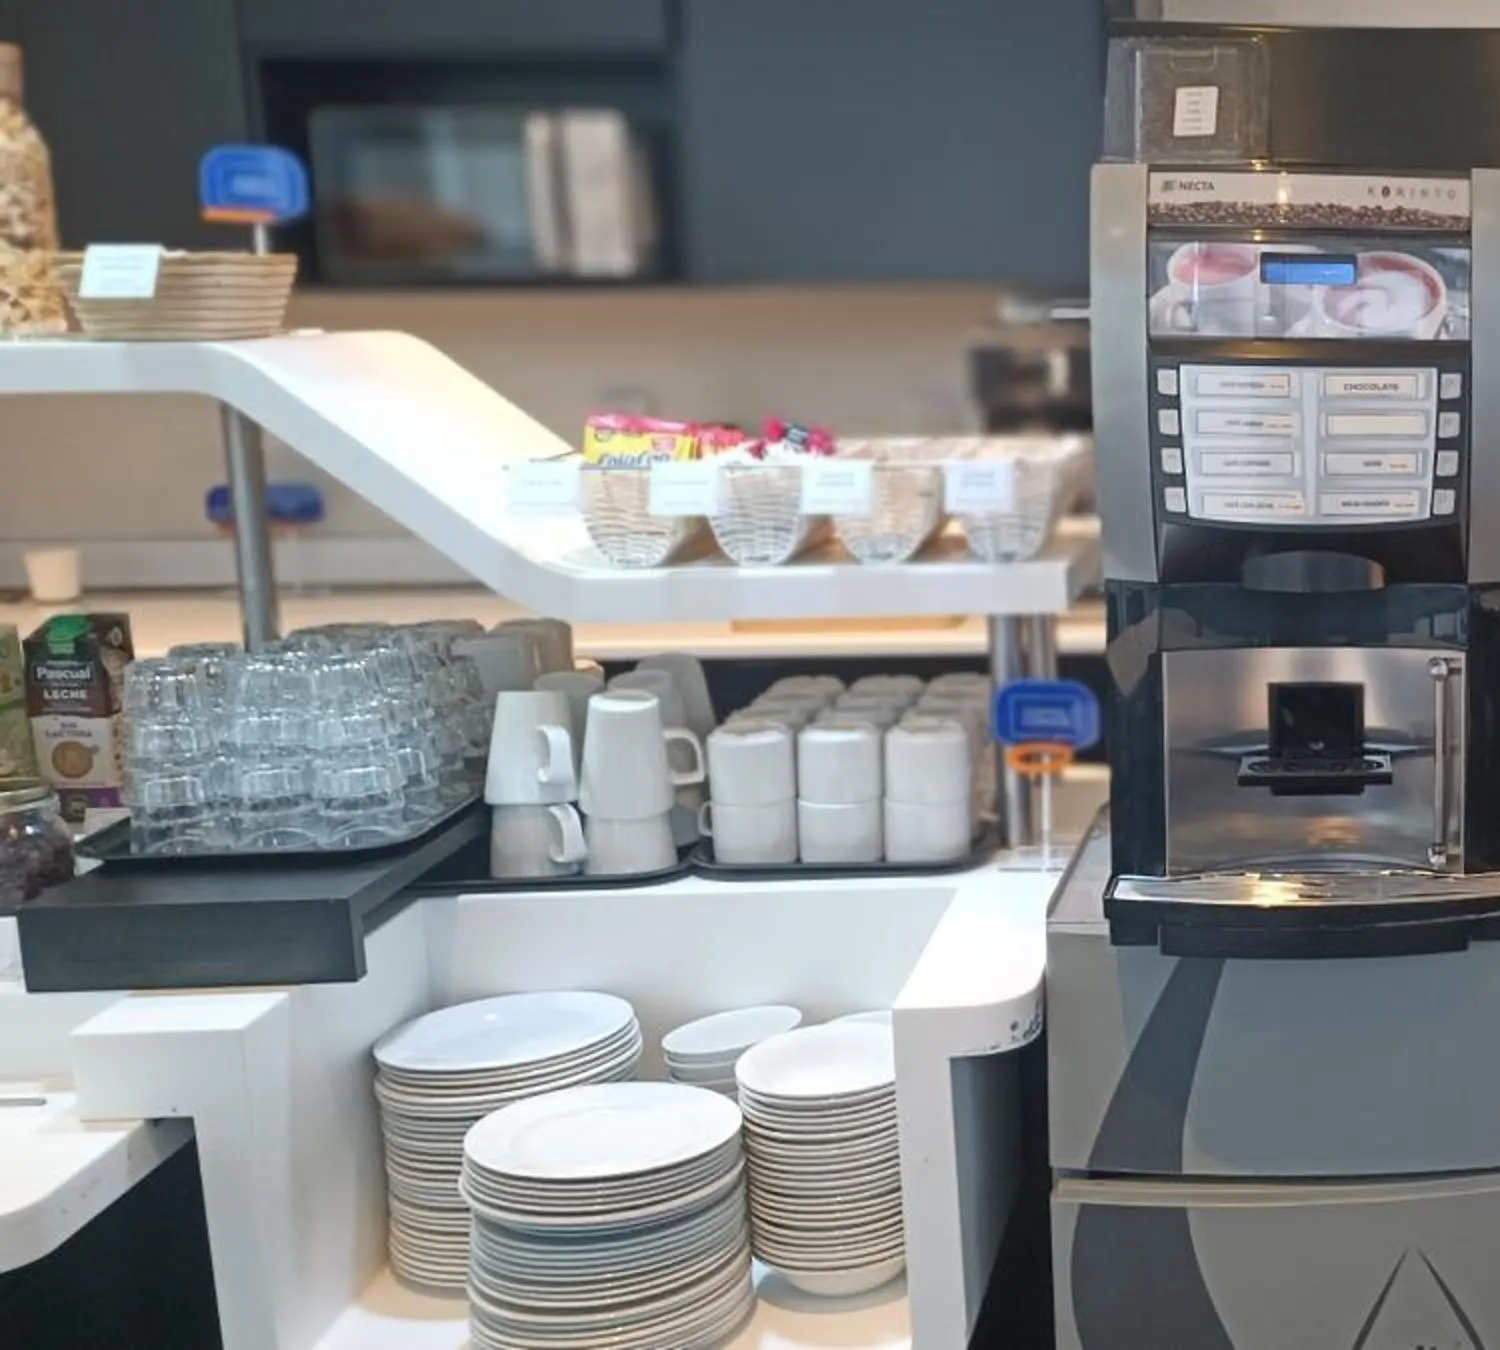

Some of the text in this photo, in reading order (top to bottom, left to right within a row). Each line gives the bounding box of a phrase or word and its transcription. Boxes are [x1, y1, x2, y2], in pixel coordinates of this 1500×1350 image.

[1178, 180, 1215, 191] NECTA
[1343, 382, 1399, 391] CHOCOLATE
[36, 666, 91, 681] Pascual
[43, 688, 88, 700] LECHE
